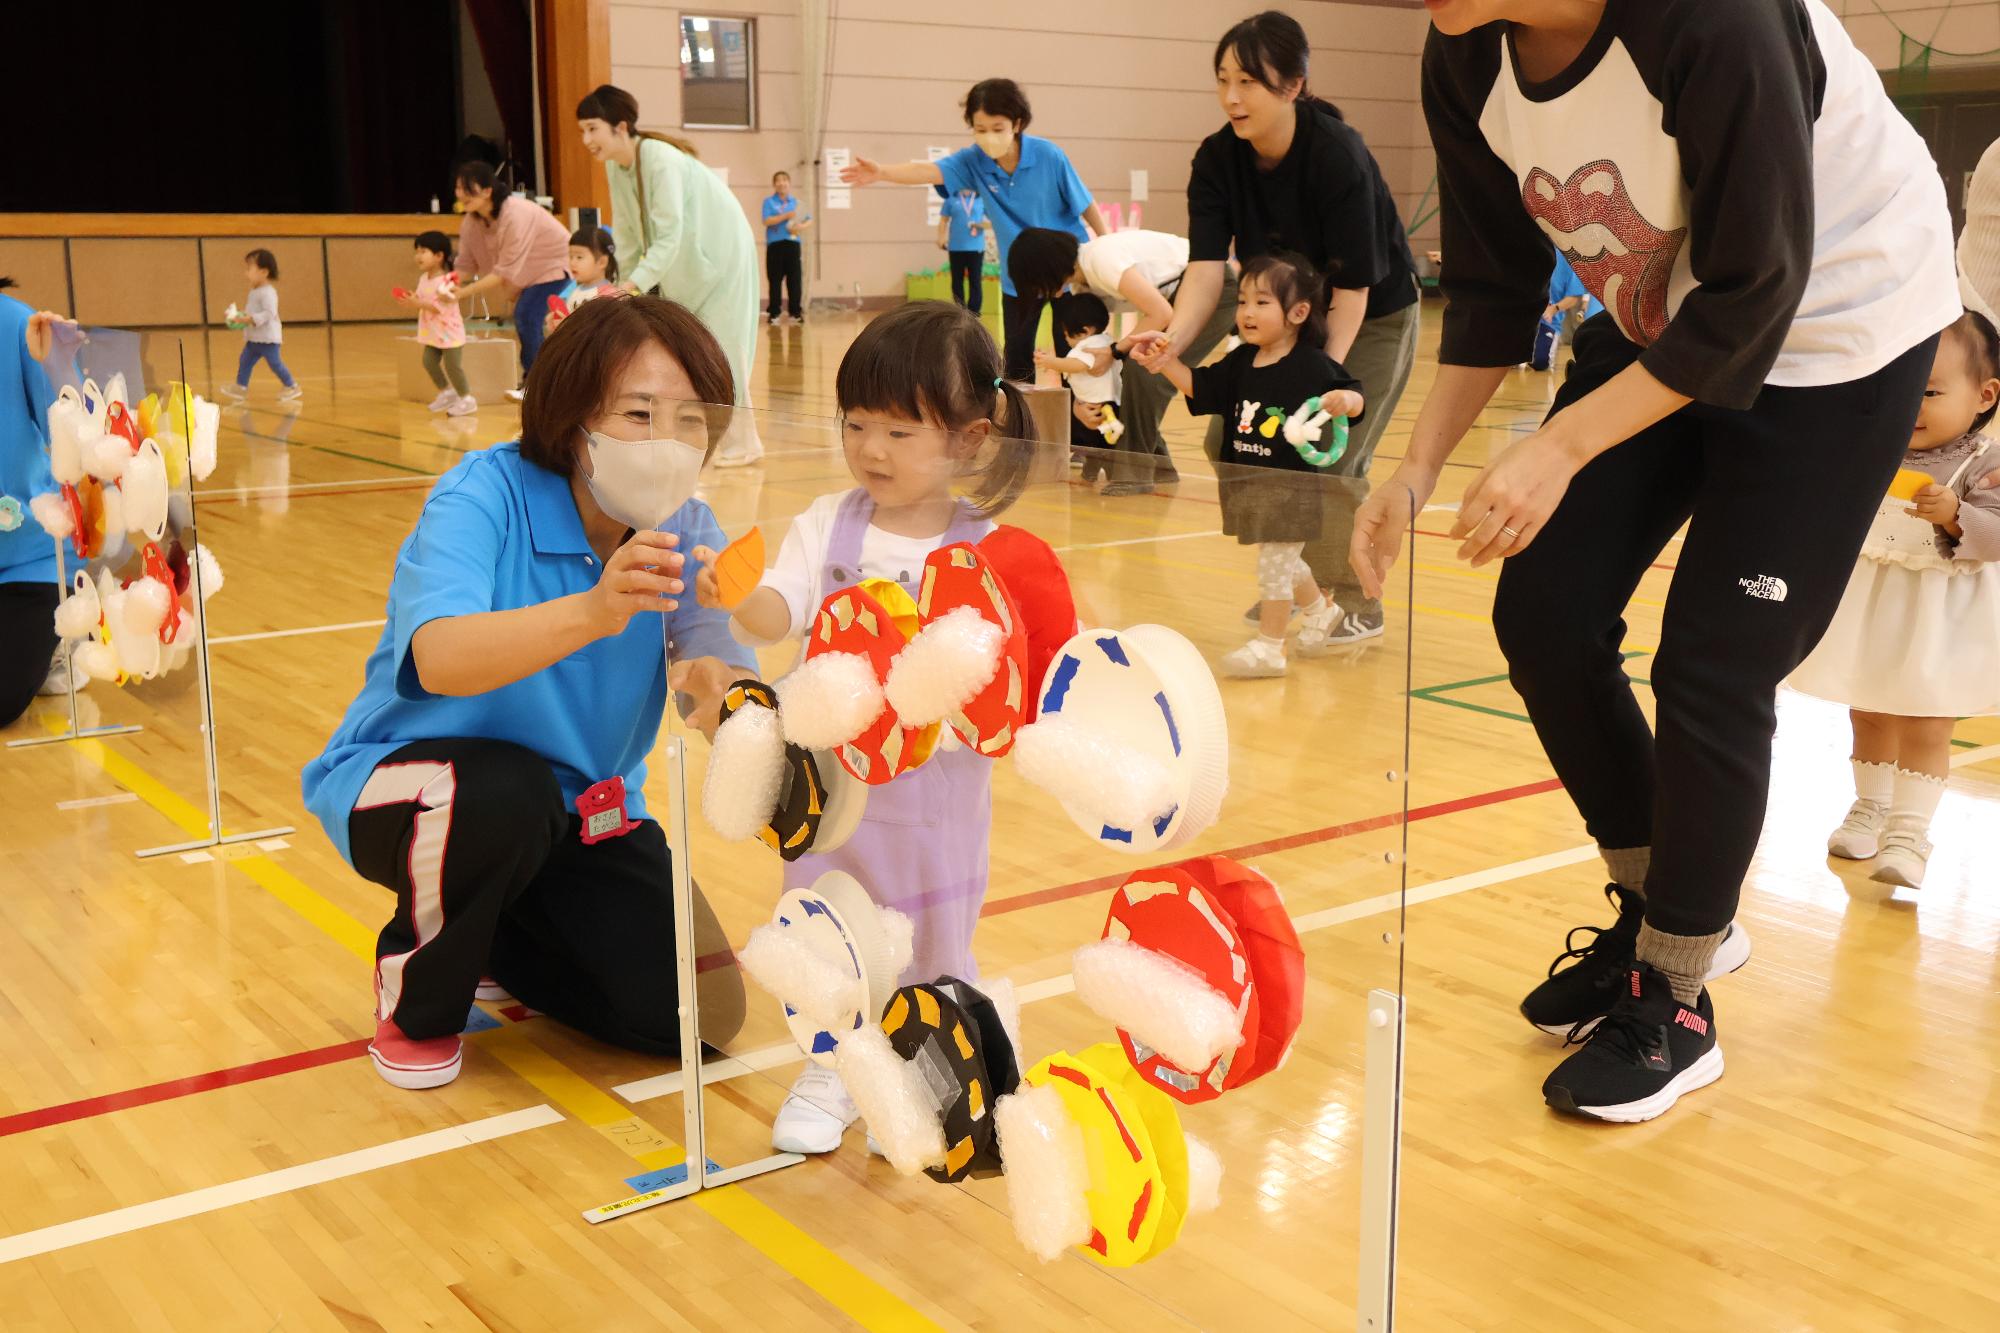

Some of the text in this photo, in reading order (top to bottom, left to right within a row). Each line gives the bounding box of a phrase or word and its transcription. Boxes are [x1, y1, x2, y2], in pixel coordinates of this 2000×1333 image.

[1738, 577, 1774, 592] NORTH
[1758, 574, 1776, 585] THE
[1745, 587, 1770, 600] FACE
[1631, 970, 1641, 998] PUMA
[1674, 1007, 1708, 1037] PUMA
